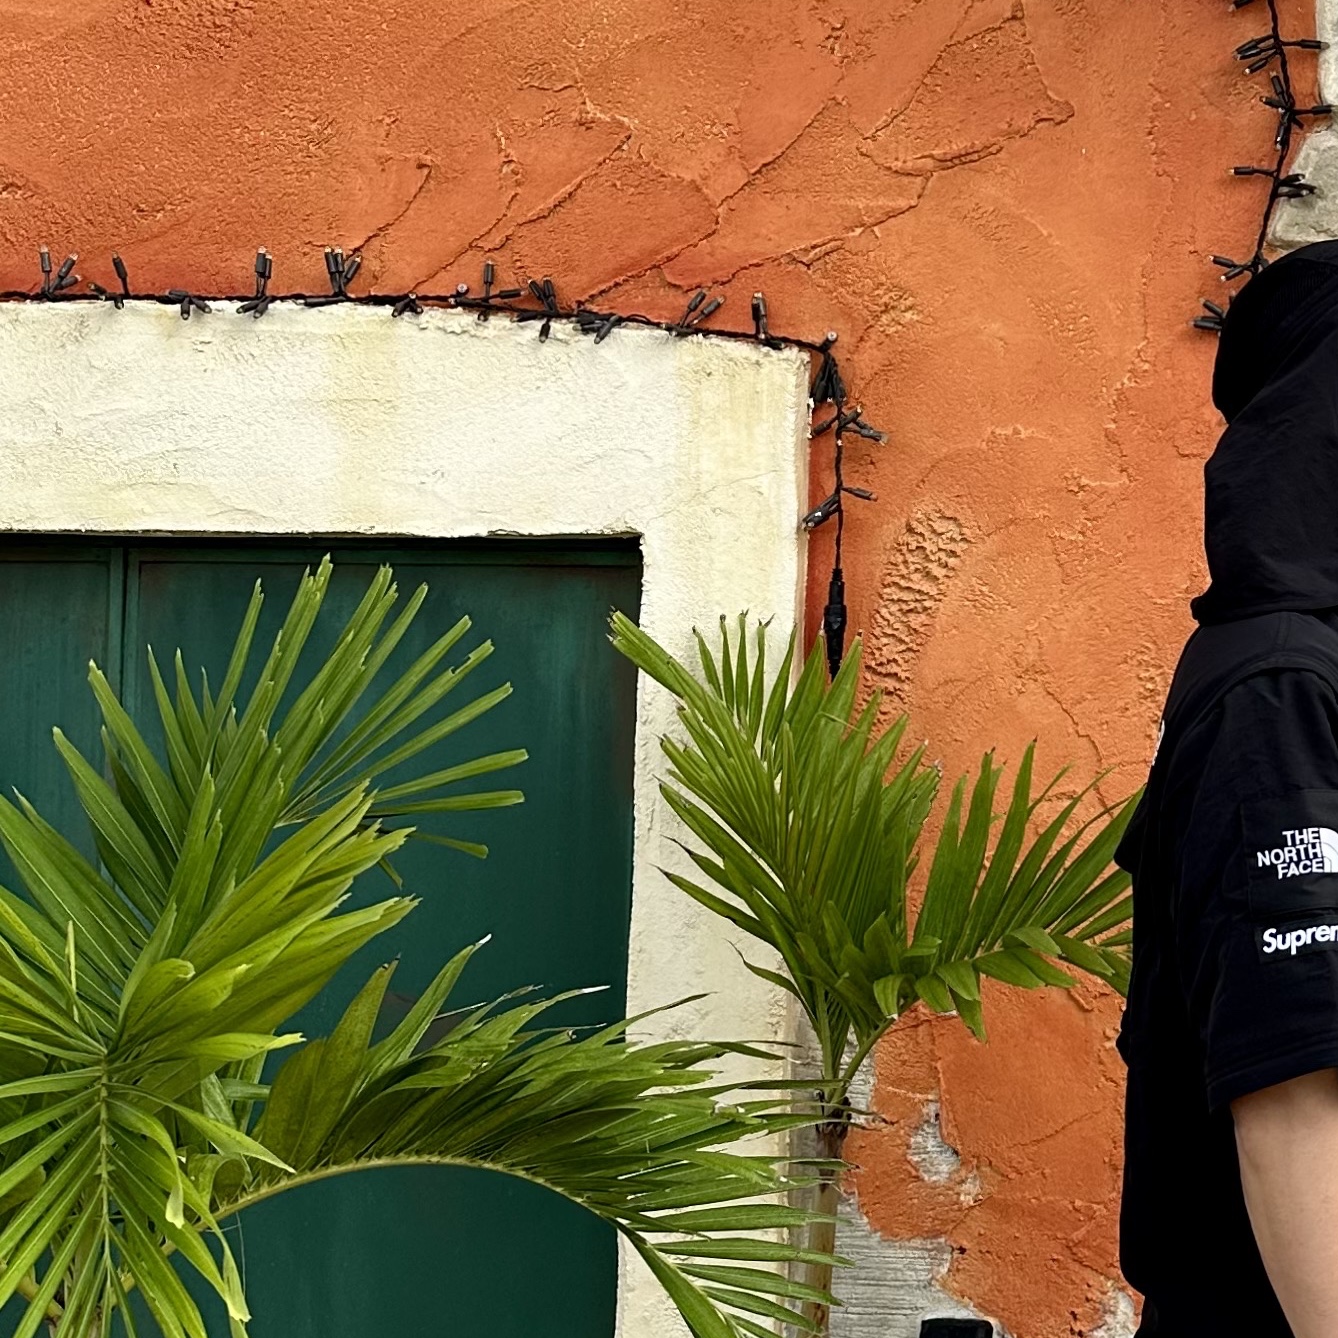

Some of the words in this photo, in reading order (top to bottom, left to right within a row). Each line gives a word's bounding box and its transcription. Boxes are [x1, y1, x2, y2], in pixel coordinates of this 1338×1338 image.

[1282, 827, 1320, 847] THE
[1257, 842, 1321, 868] NORTH
[1277, 858, 1325, 880] FACE
